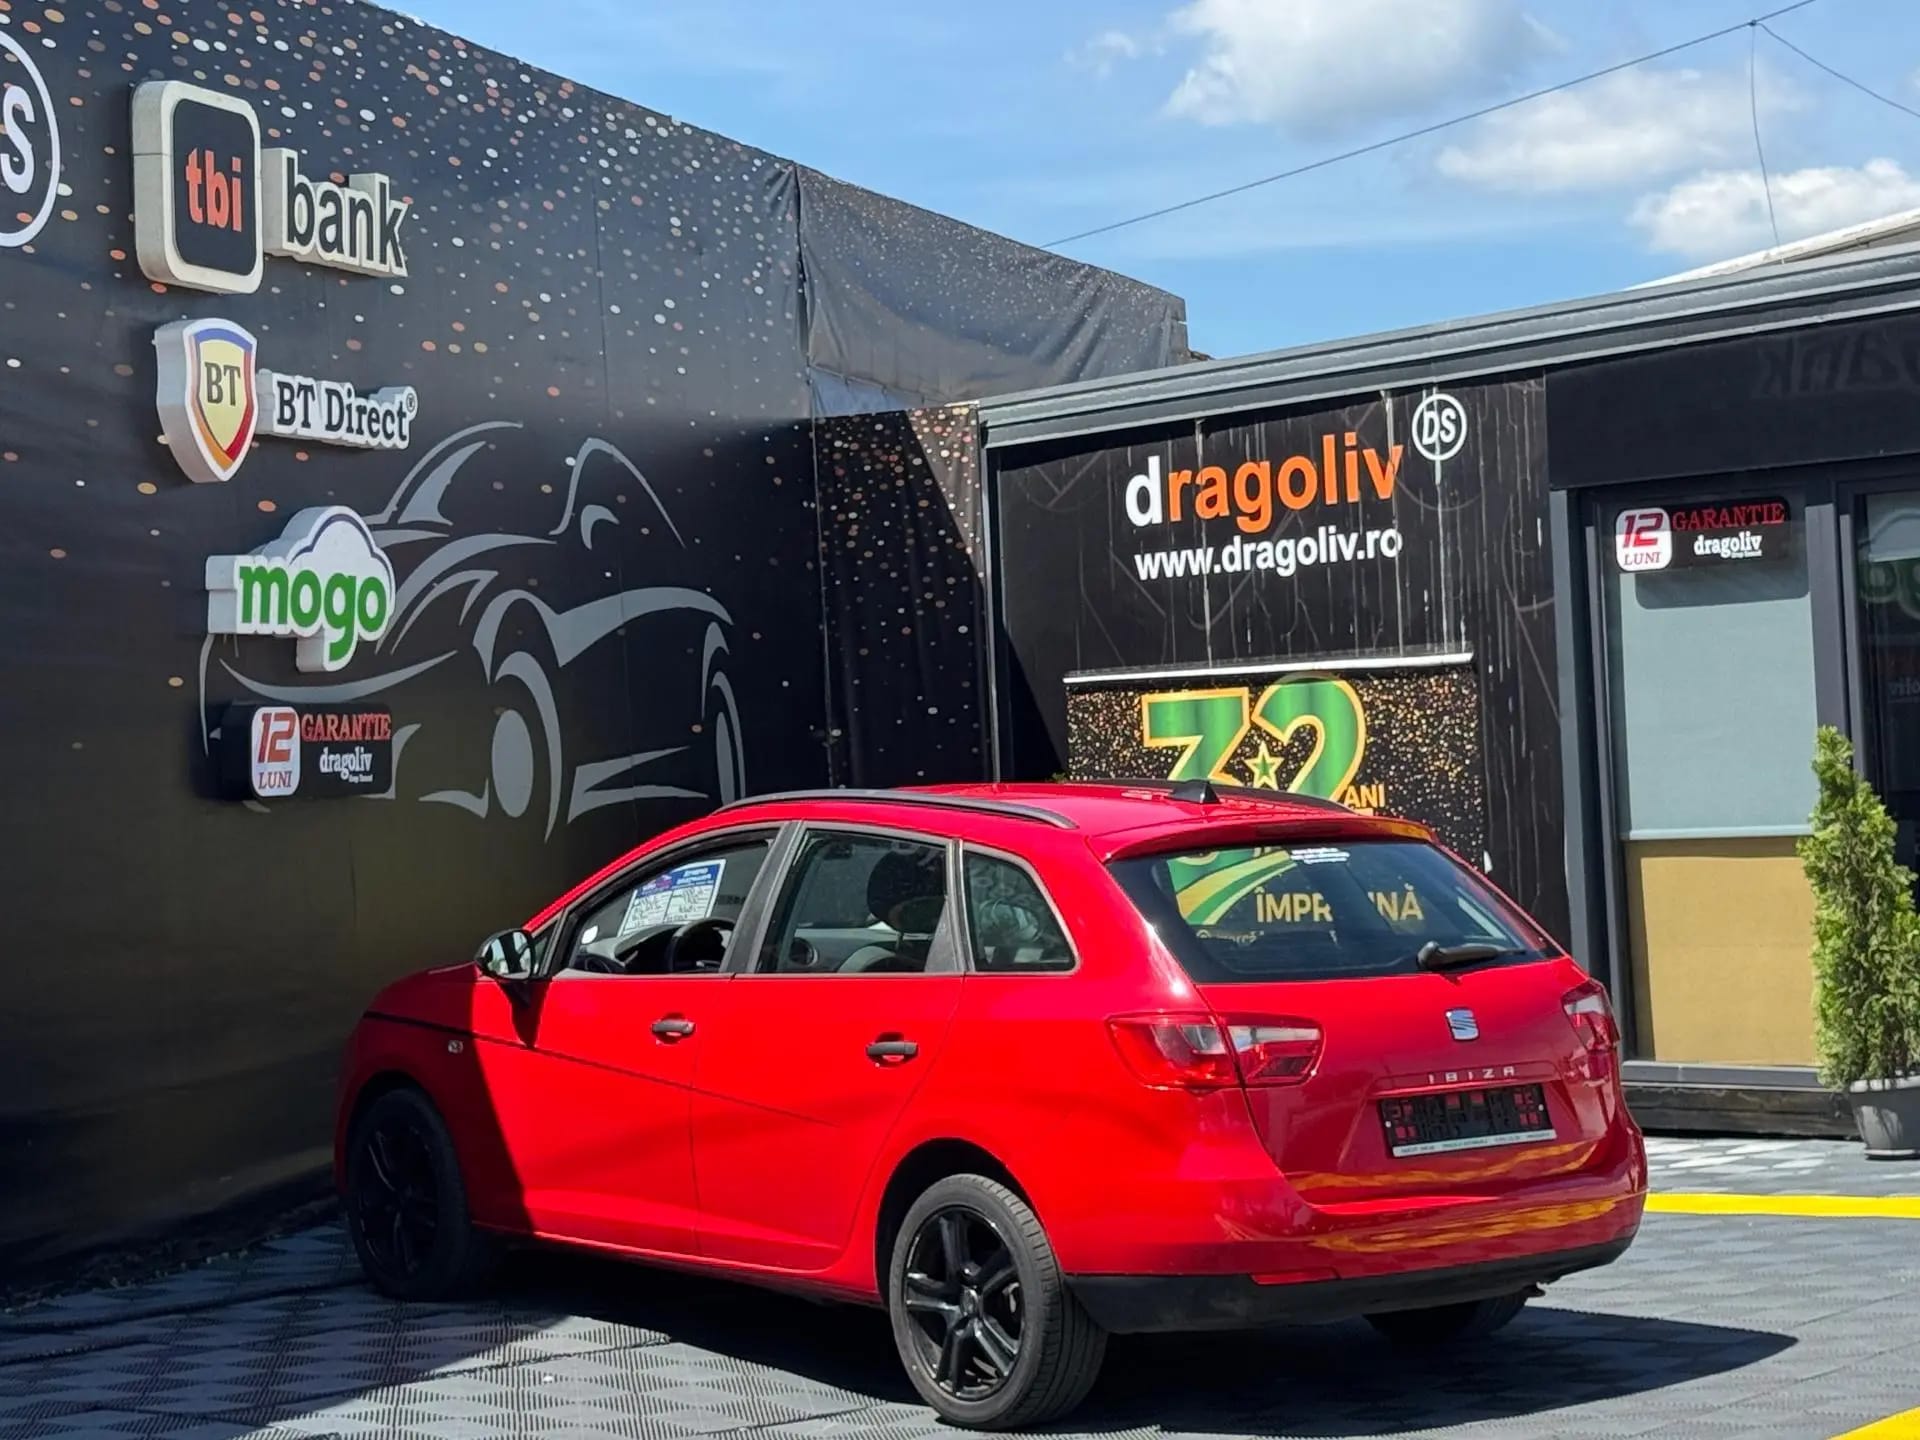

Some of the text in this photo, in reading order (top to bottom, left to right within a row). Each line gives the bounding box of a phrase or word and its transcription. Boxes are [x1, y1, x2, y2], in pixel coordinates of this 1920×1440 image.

[0, 86, 35, 194] S
[185, 147, 243, 233] tbi
[285, 155, 405, 271] bank
[204, 361, 241, 407] BT
[276, 379, 316, 430] BT
[1421, 407, 1457, 446] DS
[1124, 430, 1404, 534] dragoliv
[1621, 502, 1786, 549] 12 GARANTIE
[1693, 530, 1763, 559] dragoliv
[1134, 525, 1404, 581] www.dragoliv.ro
[1623, 551, 1662, 567] LUNI
[239, 564, 388, 664] mogo
[257, 711, 392, 764] 12 GARANTIE
[257, 770, 293, 790] LUNI
[319, 745, 373, 781] dragoliv
[1343, 782, 1386, 809] ANI
[1427, 1065, 1516, 1085] IBIZA
